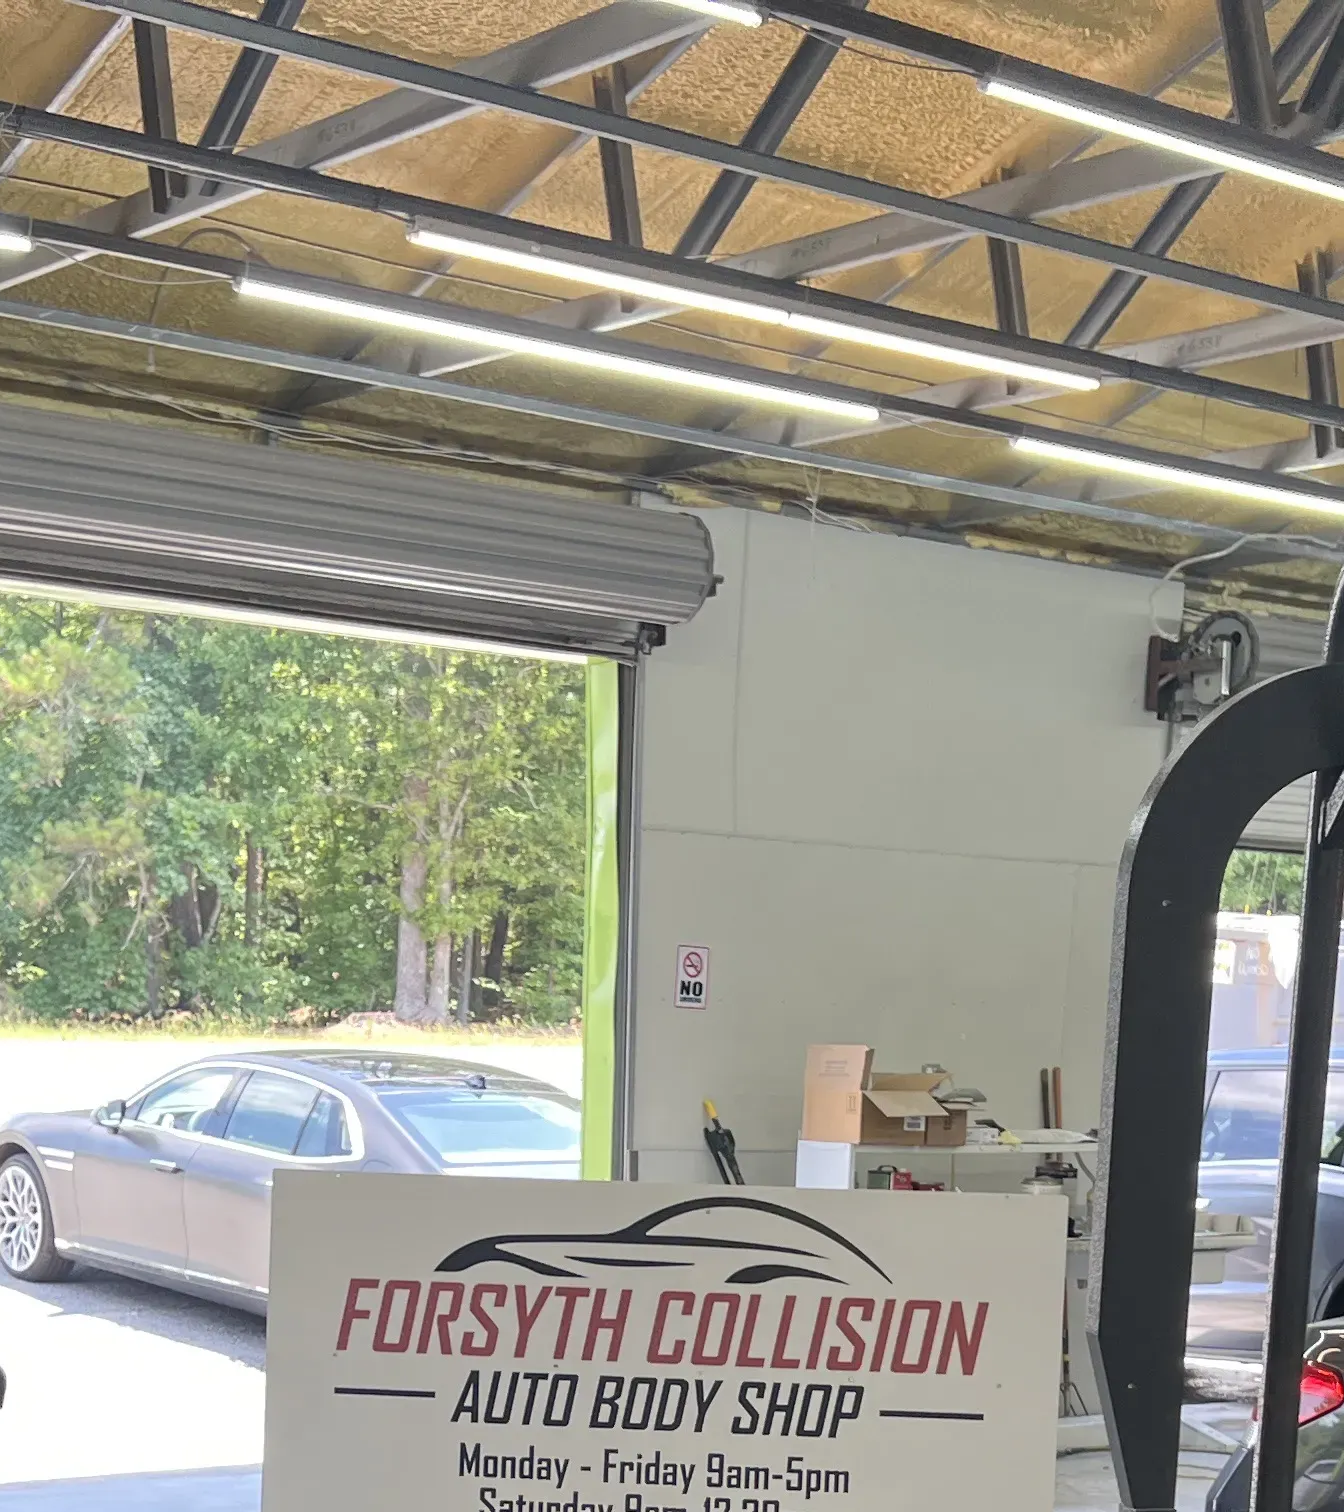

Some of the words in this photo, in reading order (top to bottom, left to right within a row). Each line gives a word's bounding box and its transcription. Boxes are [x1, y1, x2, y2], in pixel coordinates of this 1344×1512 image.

[679, 979, 703, 997] NO
[335, 1277, 633, 1363] FORSYTH
[648, 1290, 991, 1376] COLLISION
[451, 1370, 579, 1429] AUTO
[588, 1375, 724, 1435] BODY
[730, 1381, 865, 1440] SHOP
[457, 1442, 570, 1488] Monday
[602, 1450, 697, 1495] Friday
[706, 1453, 851, 1496] 9am-5pm
